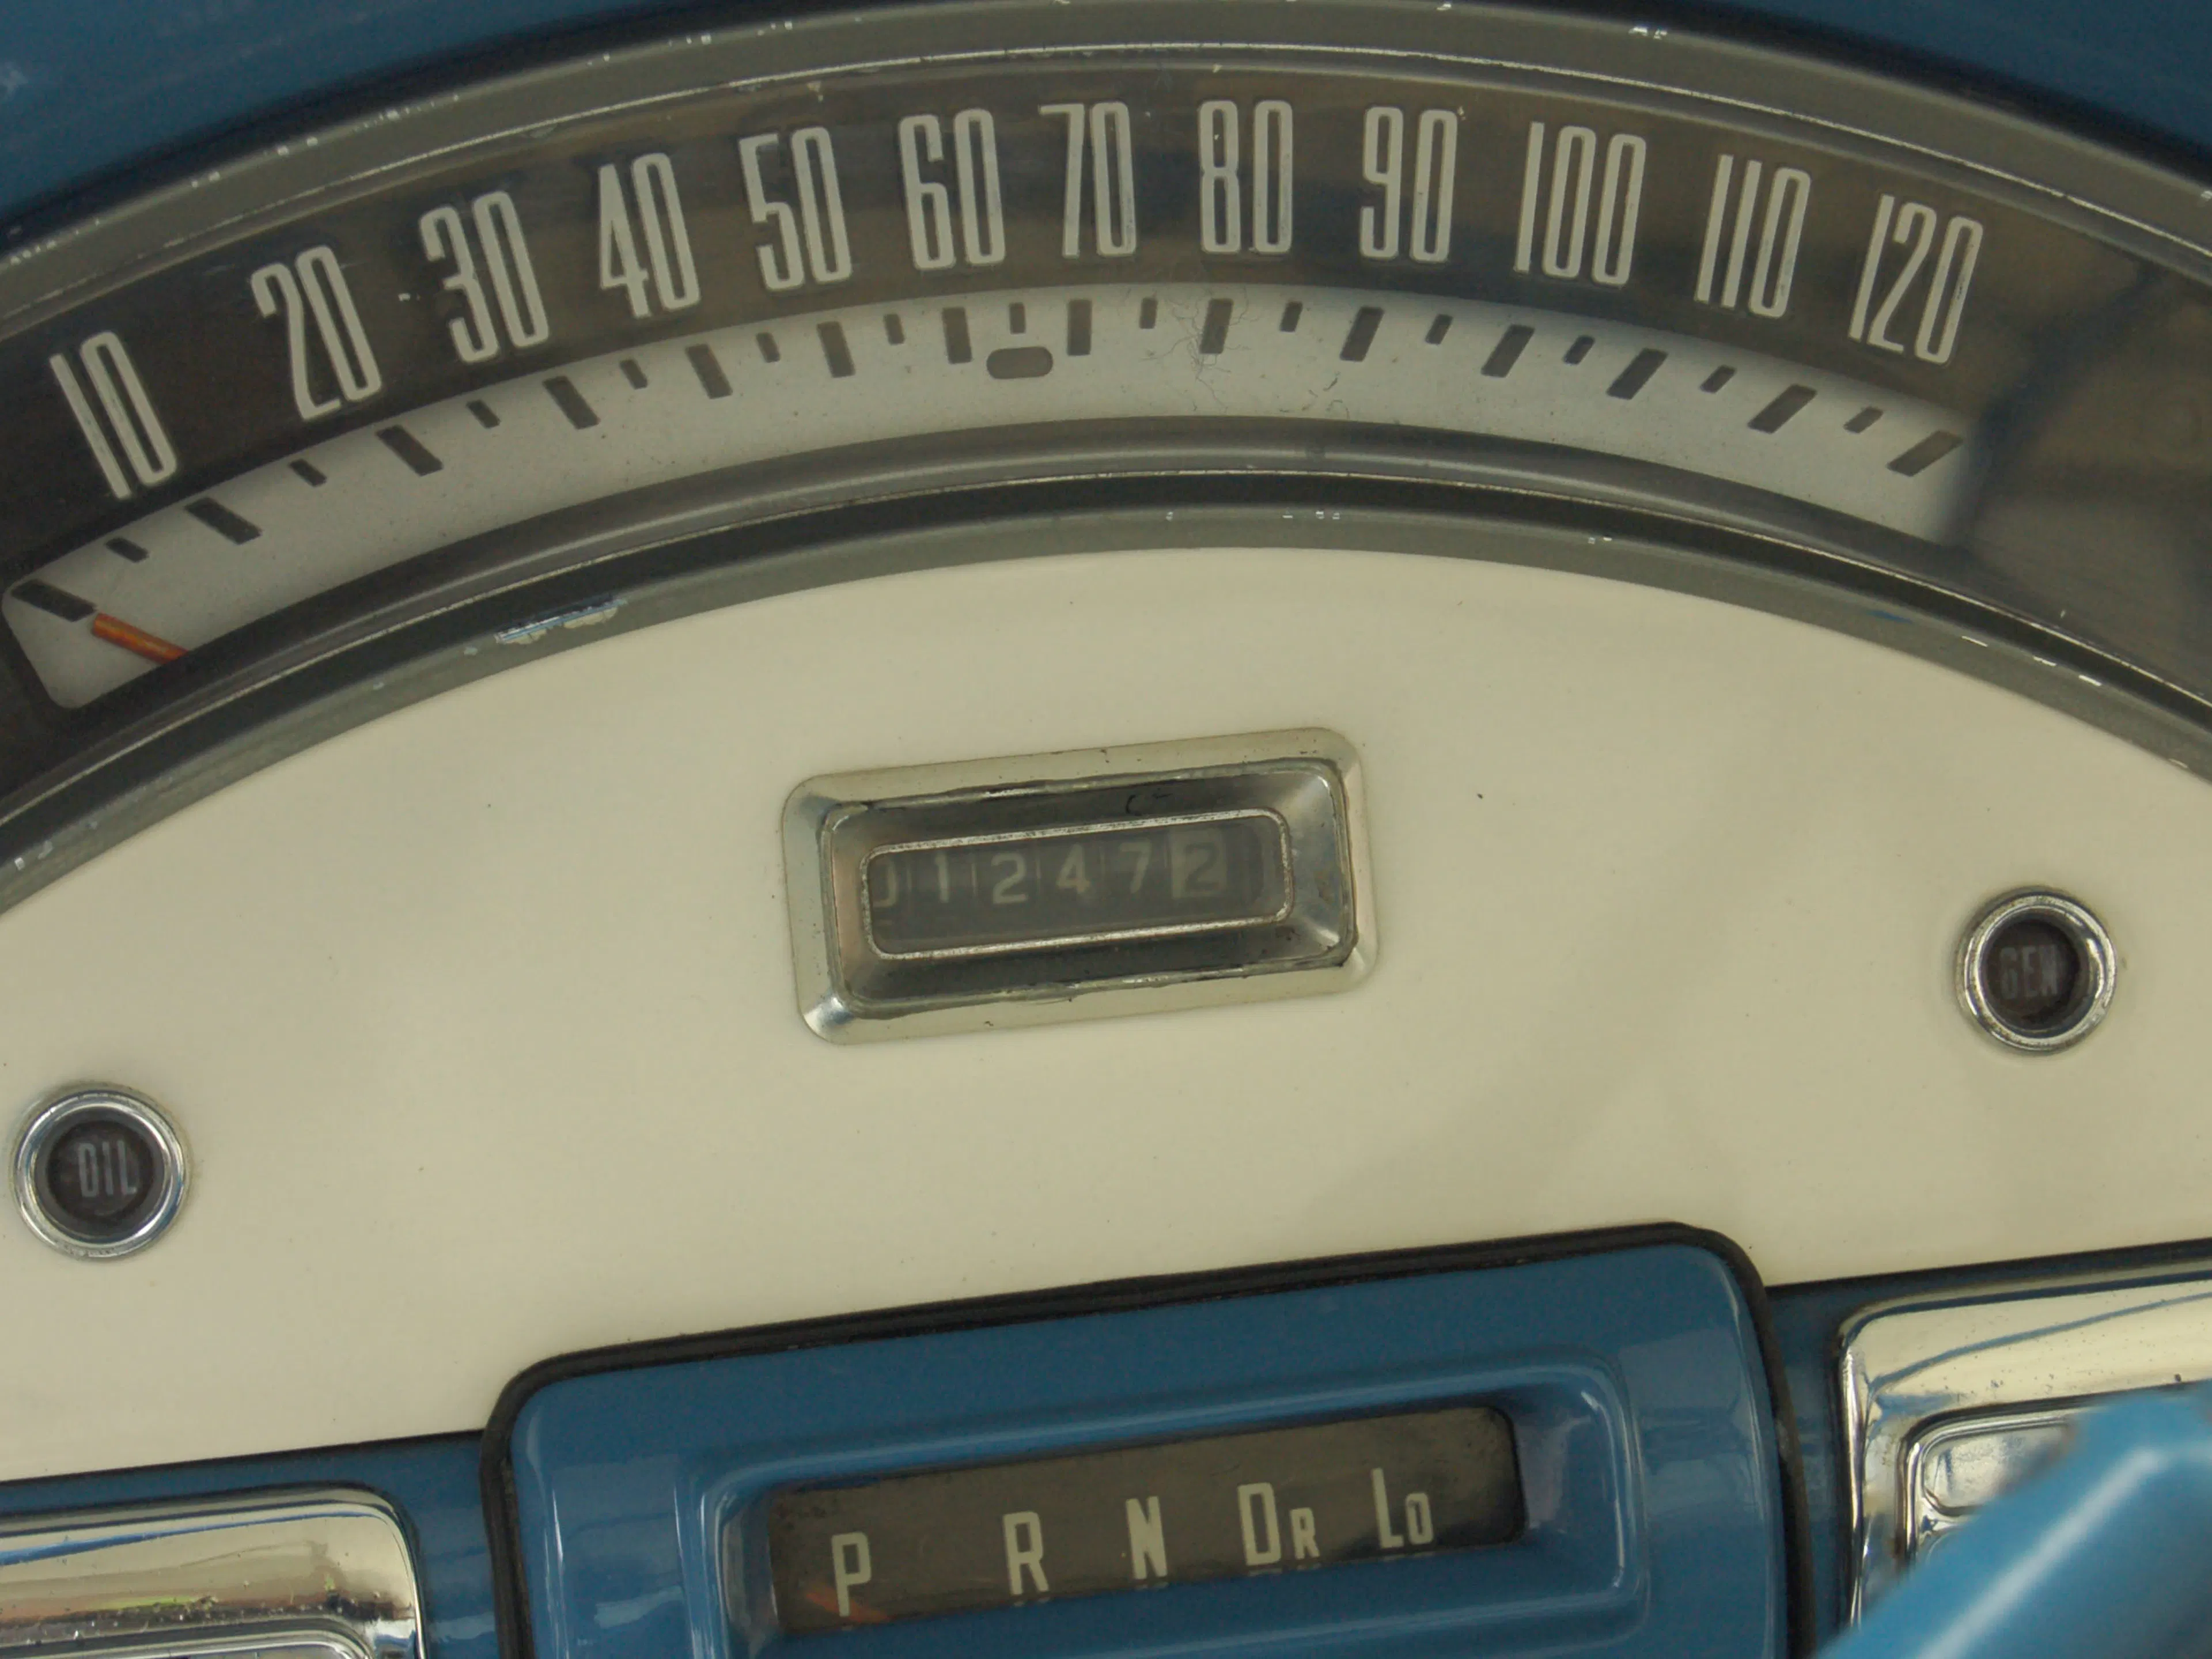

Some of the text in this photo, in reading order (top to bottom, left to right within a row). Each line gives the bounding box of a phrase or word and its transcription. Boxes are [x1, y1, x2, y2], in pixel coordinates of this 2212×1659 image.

[50, 100, 1983, 499] 10 20 30 40 50 60 70 80 90 100 110 120
[1999, 944, 2059, 999] GEN
[77, 1139, 138, 1198] OIL
[831, 1532, 872, 1617] P
[1003, 1510, 1049, 1594] R
[1126, 1496, 1167, 1580] N
